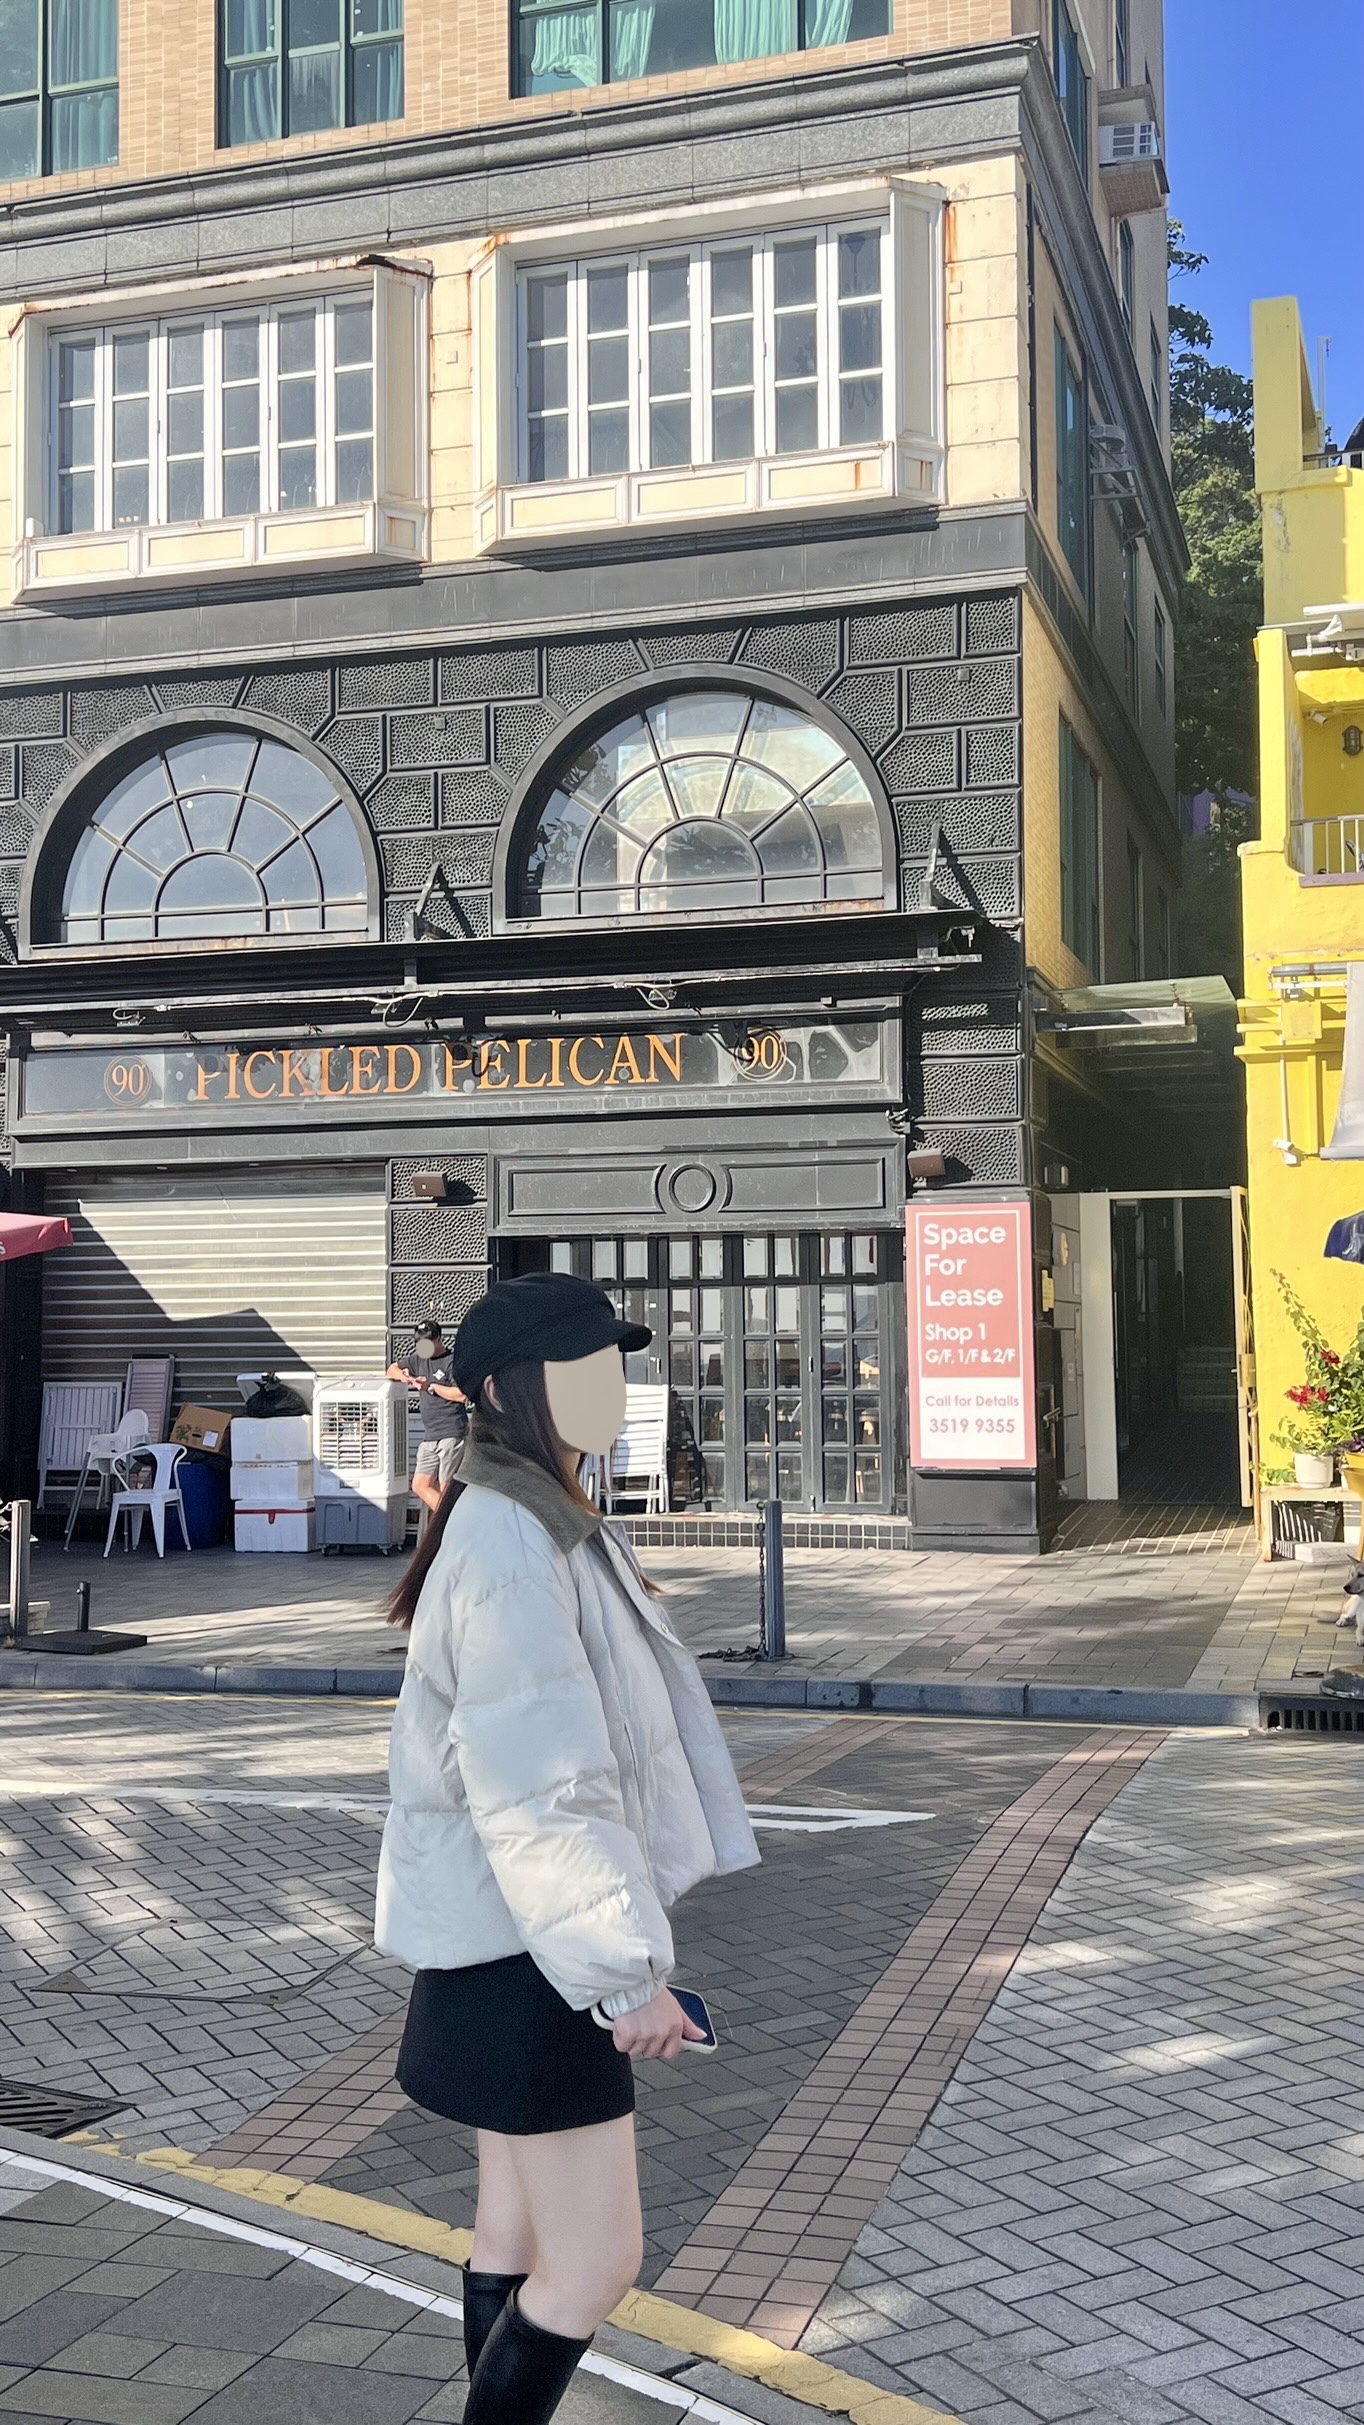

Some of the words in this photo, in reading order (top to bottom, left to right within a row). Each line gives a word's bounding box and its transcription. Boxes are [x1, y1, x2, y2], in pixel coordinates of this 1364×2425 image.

[111, 1063, 144, 1097] 90
[194, 1044, 422, 1101] PICKLED
[440, 1033, 686, 1091] PELICAN
[741, 1034, 779, 1070] 90
[923, 1222, 1007, 1250] Space
[924, 1253, 967, 1276] For
[925, 1284, 1004, 1307] Lease
[924, 1322, 973, 1345] Shop
[977, 1322, 987, 1341] 1
[925, 1348, 956, 1365] G/F,
[957, 1348, 979, 1365] 1/F
[980, 1348, 992, 1364] &
[992, 1347, 1016, 1365] 2/F
[925, 1395, 951, 1407] Call
[954, 1395, 972, 1407] for
[975, 1394, 1020, 1407] Details
[928, 1418, 969, 1433] 3519
[975, 1418, 1015, 1433] 9355
